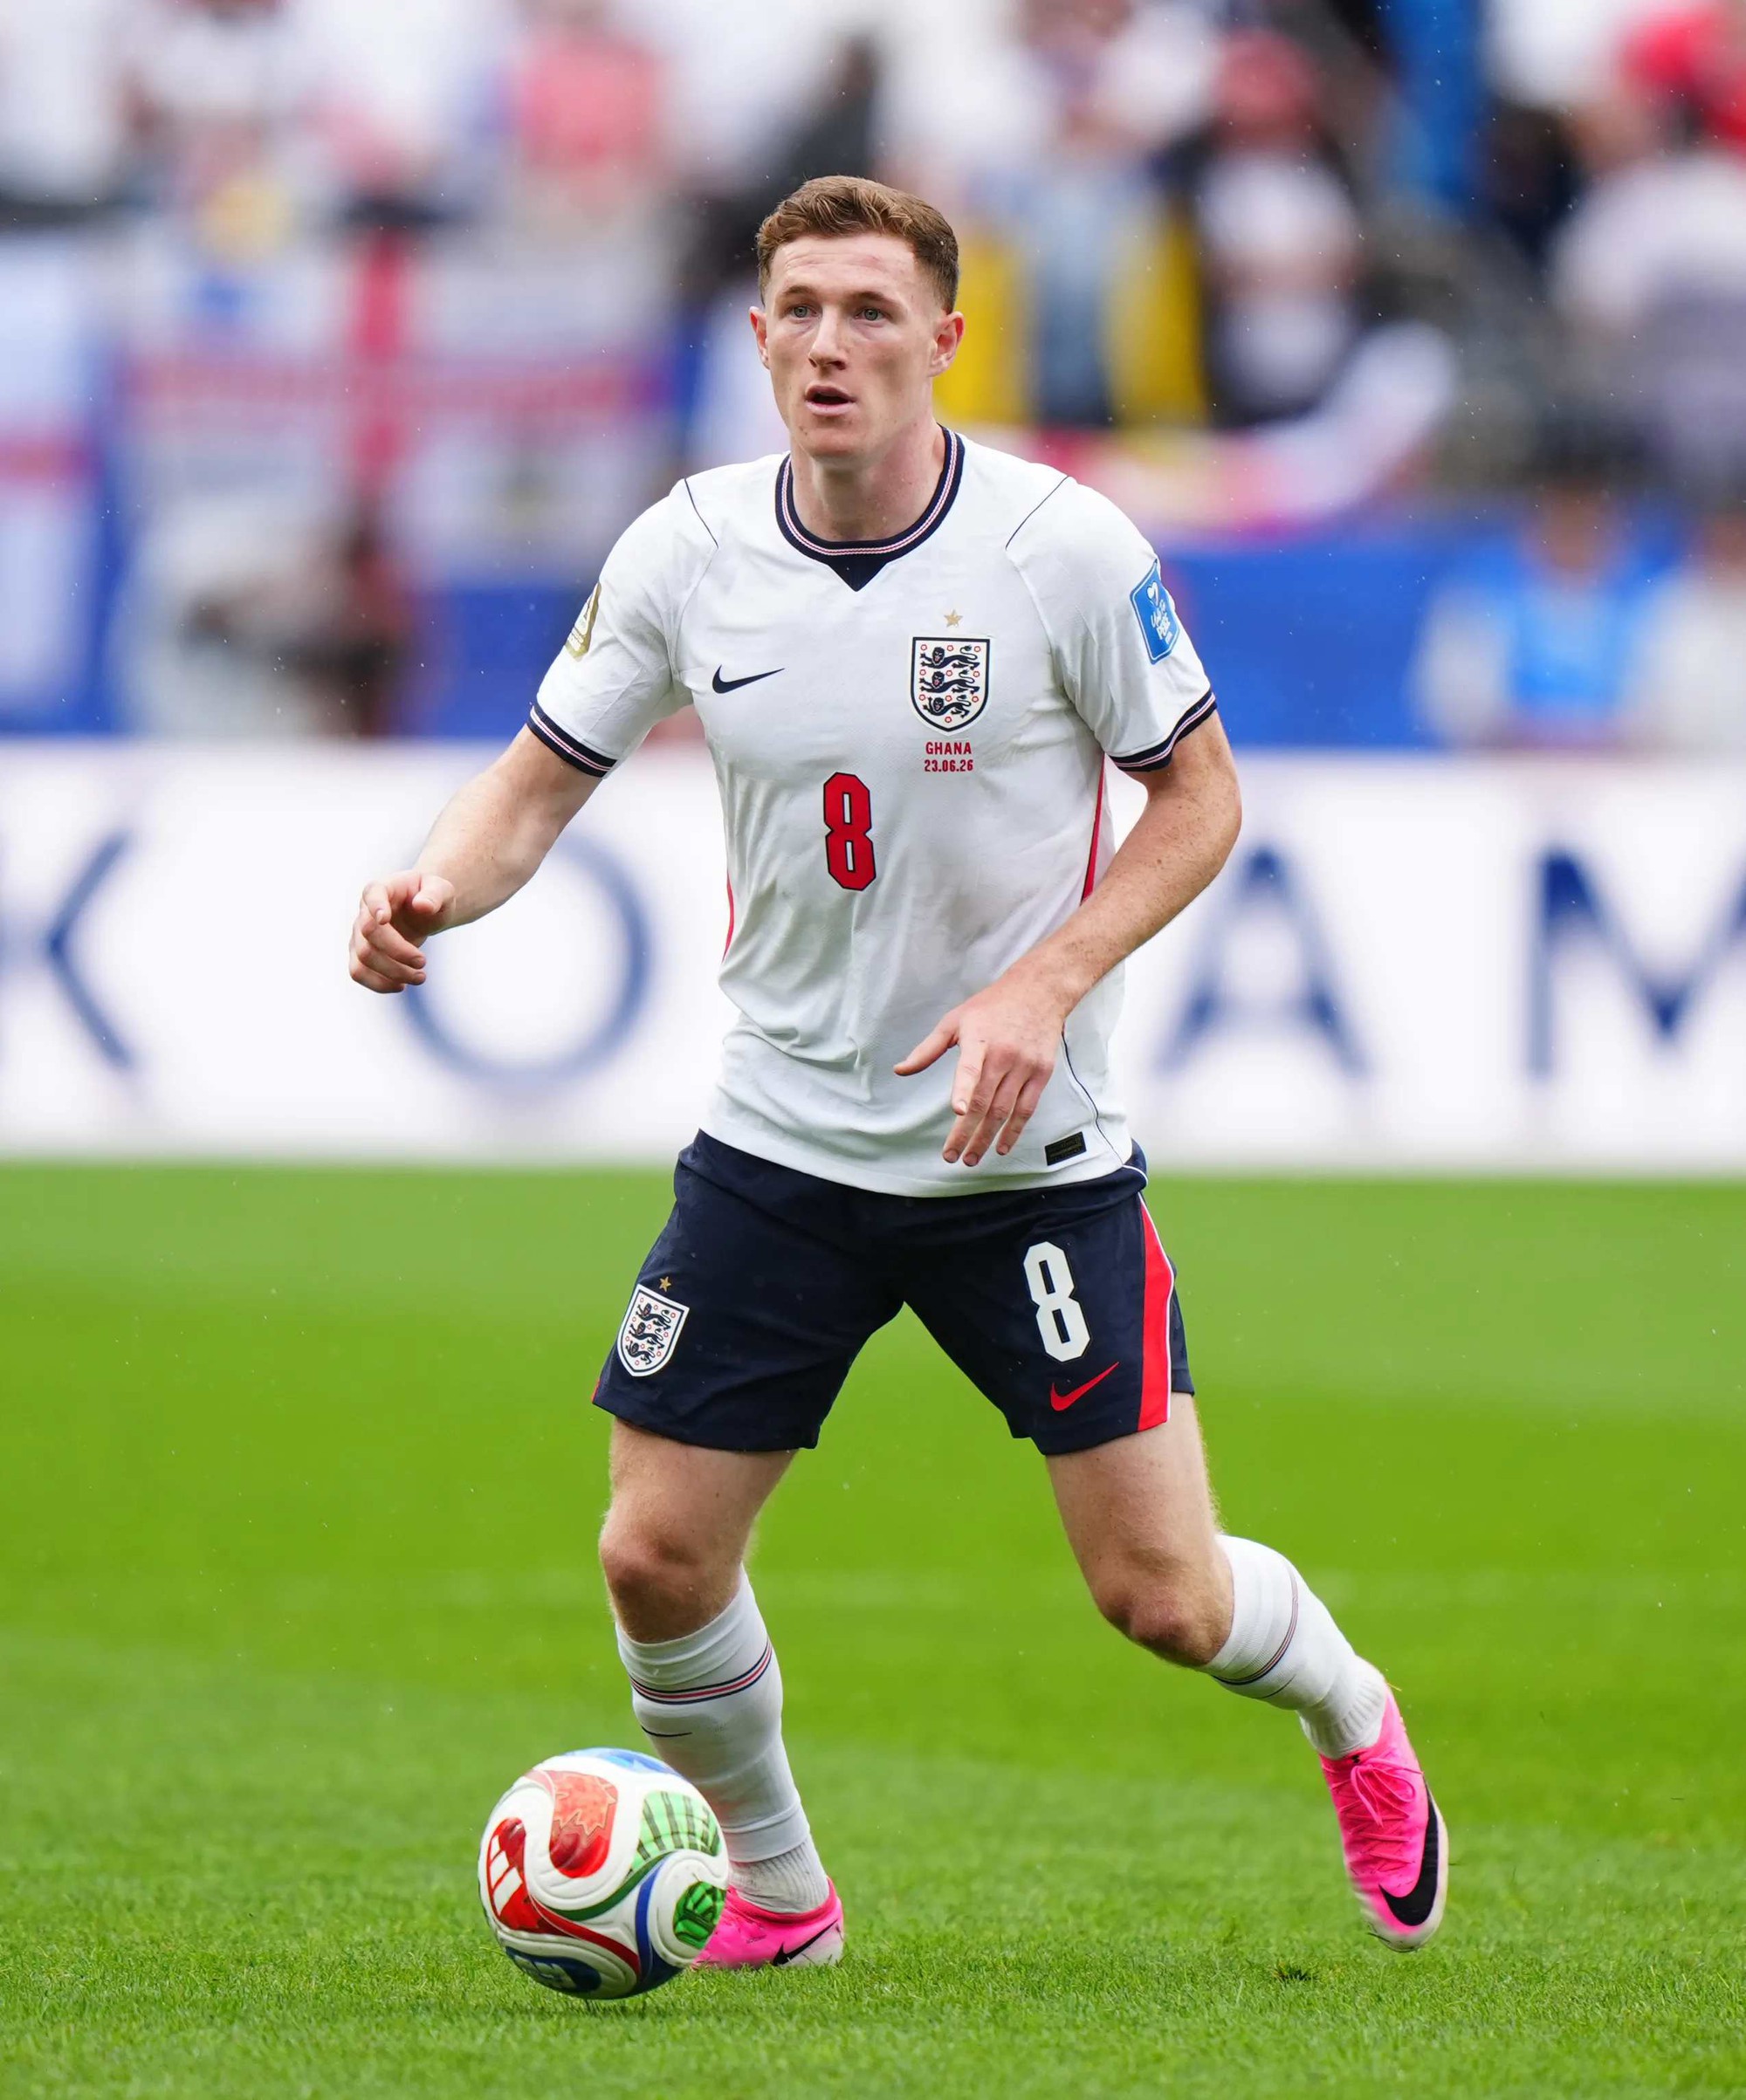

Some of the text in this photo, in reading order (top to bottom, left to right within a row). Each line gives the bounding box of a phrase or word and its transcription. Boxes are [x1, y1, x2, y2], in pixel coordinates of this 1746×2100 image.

[924, 758, 973, 772] 23.06.26
[925, 741, 972, 755] GHANA
[823, 772, 876, 891] 8
[1023, 1241, 1090, 1362] 8
